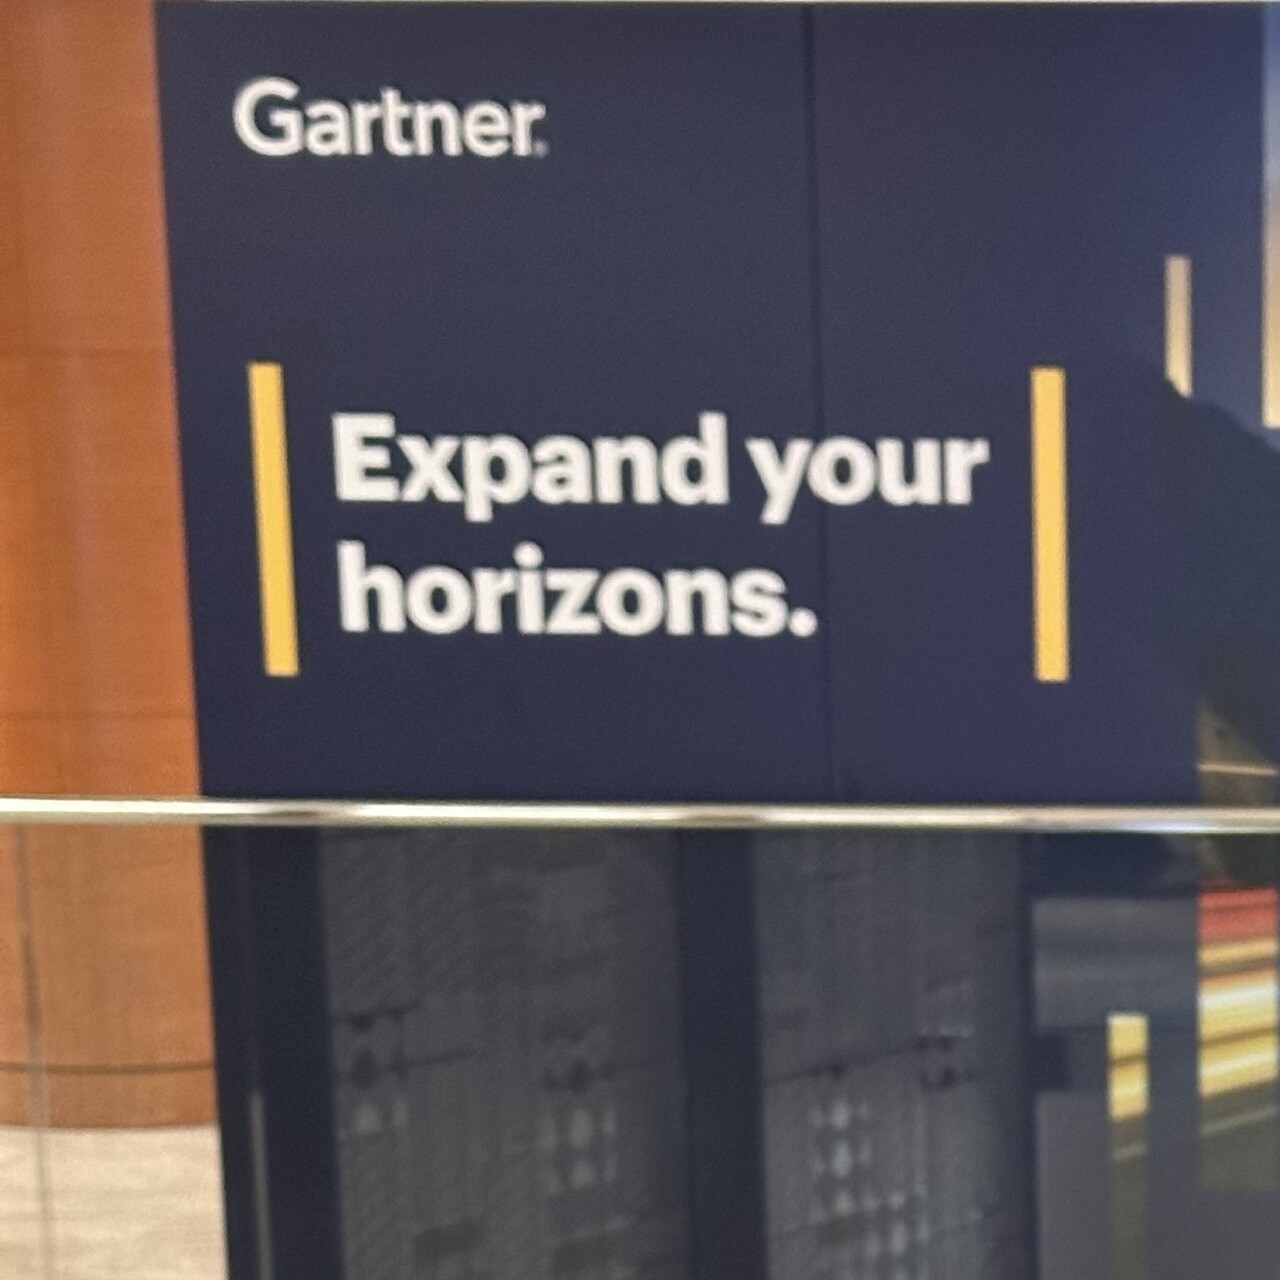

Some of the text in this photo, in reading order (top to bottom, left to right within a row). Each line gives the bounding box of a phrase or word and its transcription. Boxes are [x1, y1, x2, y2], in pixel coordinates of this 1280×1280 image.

[333, 412, 989, 524] Expand your
[337, 540, 817, 637] horizons.
